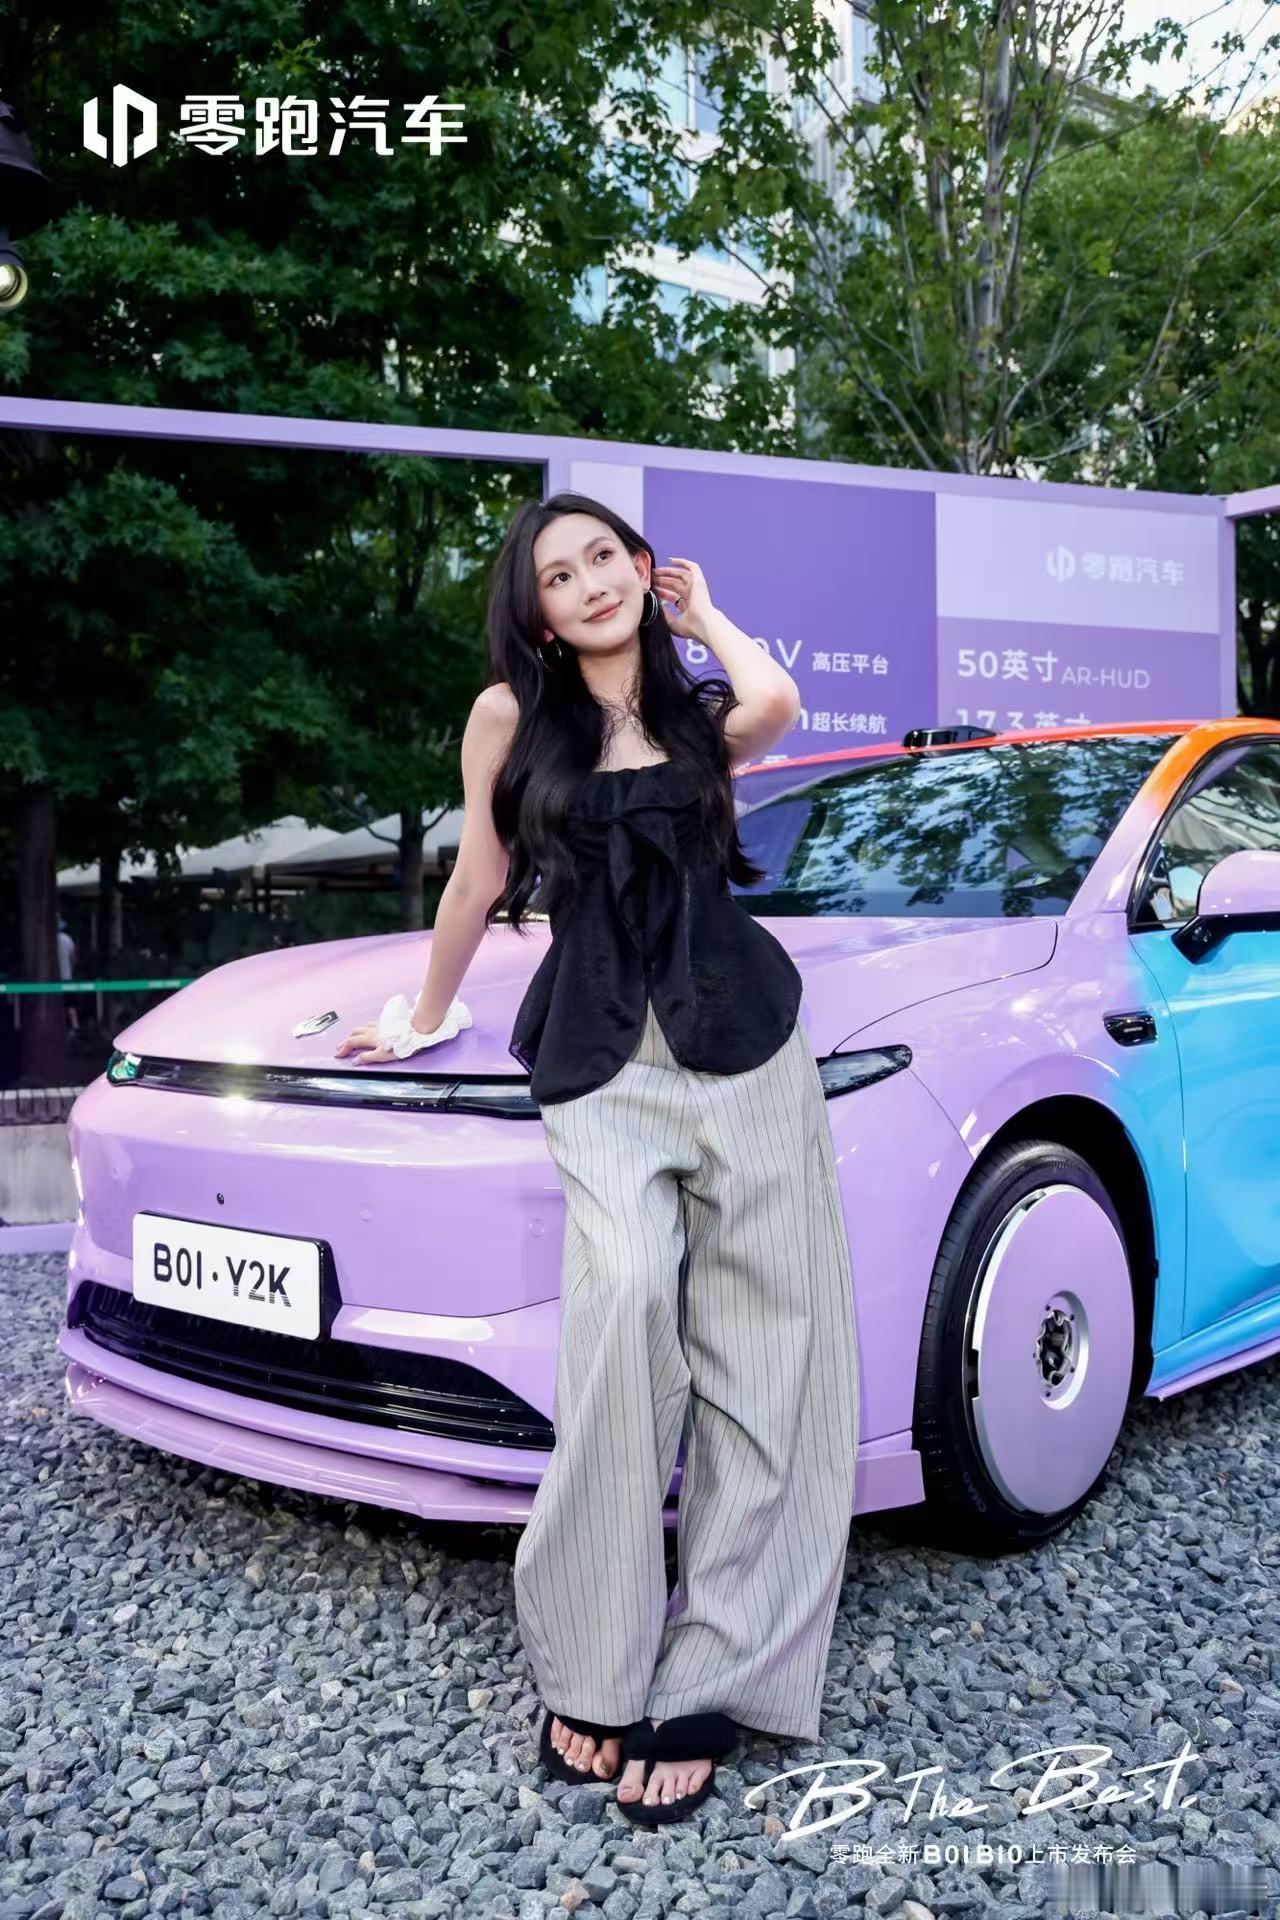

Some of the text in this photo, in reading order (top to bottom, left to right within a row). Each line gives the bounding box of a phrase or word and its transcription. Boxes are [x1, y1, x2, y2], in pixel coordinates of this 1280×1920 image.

[812, 652, 889, 675] 高压平台
[957, 648, 1150, 689] 50英寸 AR-HUD
[812, 711, 887, 735] 超长续航
